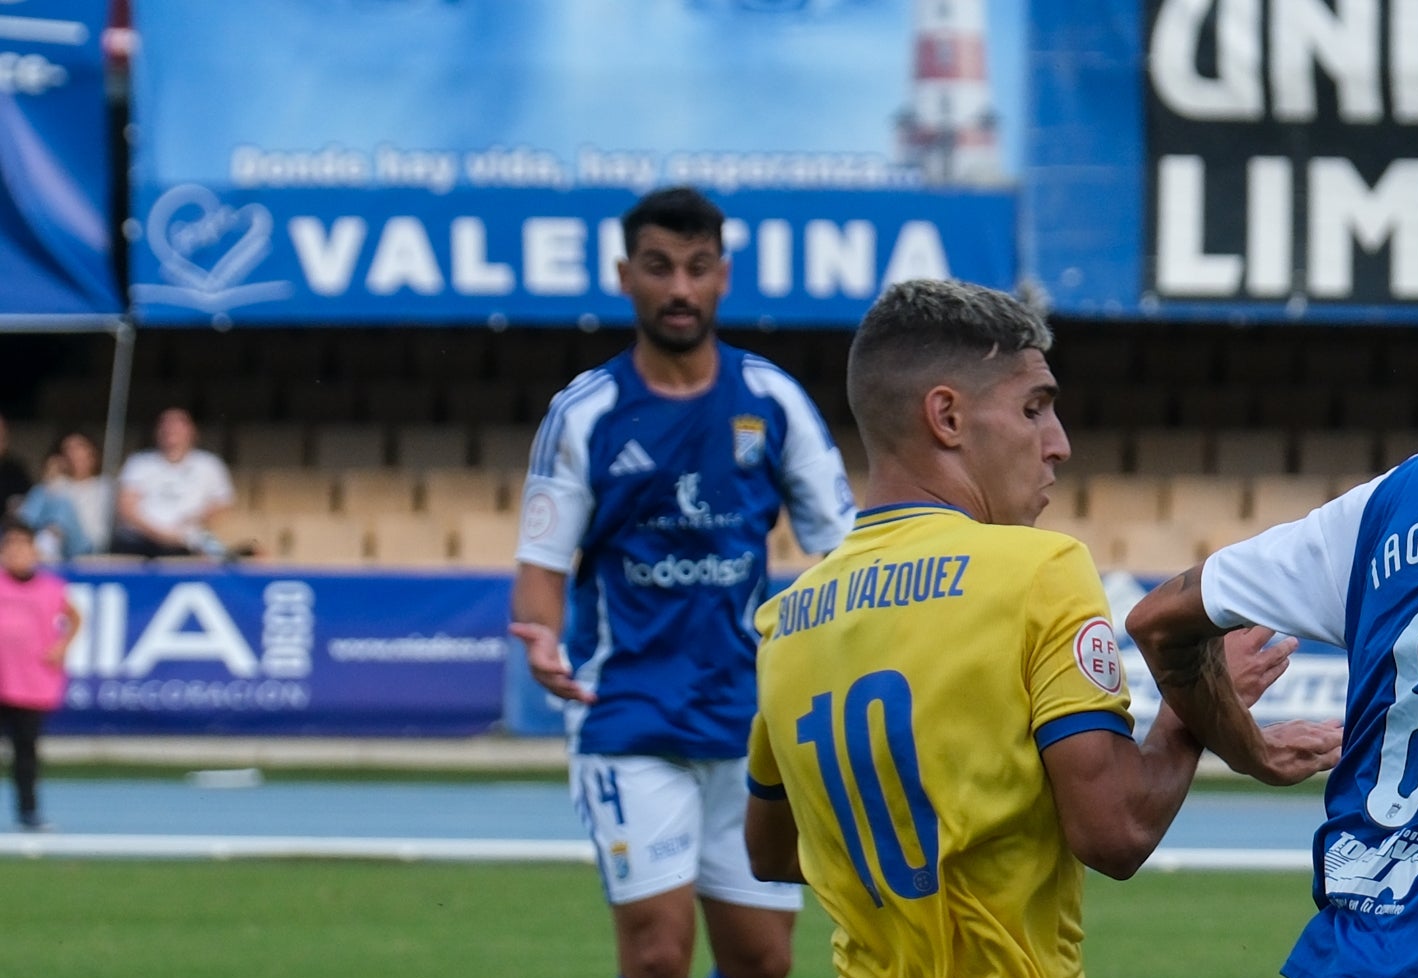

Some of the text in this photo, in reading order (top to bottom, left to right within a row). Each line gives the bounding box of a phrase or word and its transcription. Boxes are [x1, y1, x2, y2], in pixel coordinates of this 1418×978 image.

[287, 214, 951, 297] VALEINA
[845, 555, 971, 613] VÁZQUEZ
[796, 668, 940, 909] 10
